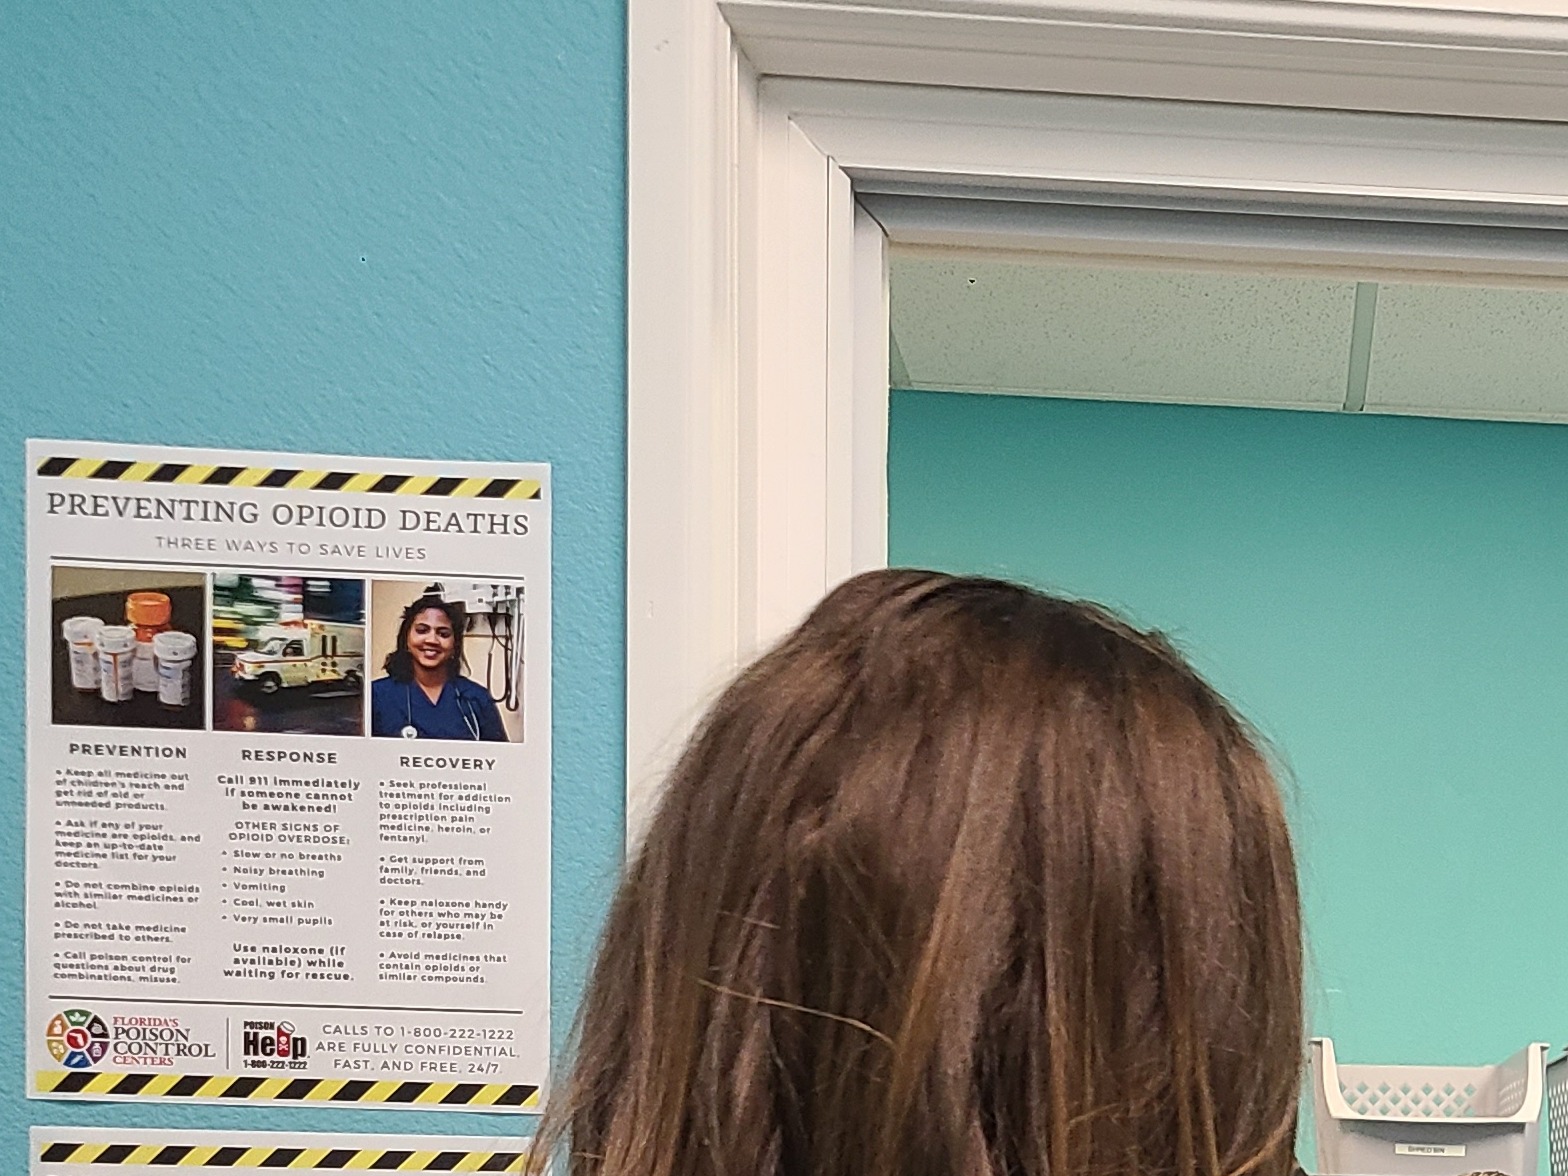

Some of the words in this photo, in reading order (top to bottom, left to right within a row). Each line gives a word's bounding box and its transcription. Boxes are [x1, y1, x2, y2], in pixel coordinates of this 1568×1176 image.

[46, 492, 259, 524] PREVENTING
[272, 503, 386, 530] OPIOID
[398, 509, 528, 536] DEATHS
[154, 535, 217, 551] THREE
[224, 538, 278, 554] WAYS
[285, 541, 311, 555] TO
[318, 543, 366, 558] SAVE
[375, 545, 426, 560] LIVES
[68, 742, 187, 759] PREVENTION
[241, 749, 337, 764] RESPONSE
[399, 755, 496, 771] RECOVERY
[217, 774, 244, 785] Call
[248, 775, 268, 786] 911
[273, 775, 360, 791] immediately
[388, 779, 415, 789] Seek
[418, 781, 487, 791] professional
[225, 786, 236, 797] if
[239, 789, 301, 800] someone
[305, 792, 353, 802] cannot
[378, 790, 435, 800] treatment
[438, 791, 454, 801] for
[457, 793, 511, 803] addiction
[241, 800, 258, 810] be
[262, 802, 336, 814] awakened!
[378, 801, 391, 810] to
[393, 801, 435, 811] opioids
[438, 802, 491, 815] including
[379, 812, 447, 822] prescription
[450, 814, 475, 824] pain
[234, 820, 277, 831] OTHER
[280, 822, 319, 833] SIGNS
[323, 824, 340, 833] OF
[227, 832, 274, 842] OPIOID
[277, 833, 350, 845] OVERDOSE:
[232, 849, 261, 859] Slow
[263, 851, 277, 859] or
[279, 852, 295, 860] no
[298, 851, 342, 862] breaths
[389, 854, 408, 864] Get
[411, 856, 455, 866] support
[458, 856, 484, 866] from
[232, 865, 265, 877] Noisy
[268, 866, 324, 879] breathing
[465, 868, 486, 877] and
[232, 881, 286, 894] Vomiting
[265, 900, 287, 908] wet
[290, 899, 314, 909] skin
[232, 913, 259, 925] Very
[262, 915, 293, 924] small
[297, 916, 333, 926] pupils
[232, 942, 257, 953] Use
[261, 944, 325, 955] naloxone
[329, 945, 346, 957] (if
[232, 956, 302, 968] available)
[306, 957, 344, 968] while
[222, 967, 276, 981] waiting
[280, 969, 301, 979] for
[112, 1016, 179, 1028] FLORIDA'S
[243, 1020, 278, 1033] POISON
[112, 1026, 191, 1042] POISON
[321, 1024, 368, 1036] CALLS
[373, 1025, 394, 1037] TO
[400, 1026, 514, 1040] 1-800-222-1222
[112, 1040, 216, 1058] CONTROL
[315, 1040, 347, 1053] ARE
[352, 1041, 398, 1054] FULLY
[112, 1055, 174, 1066] CENTERS
[242, 1059, 308, 1070] 1-800-222-1222
